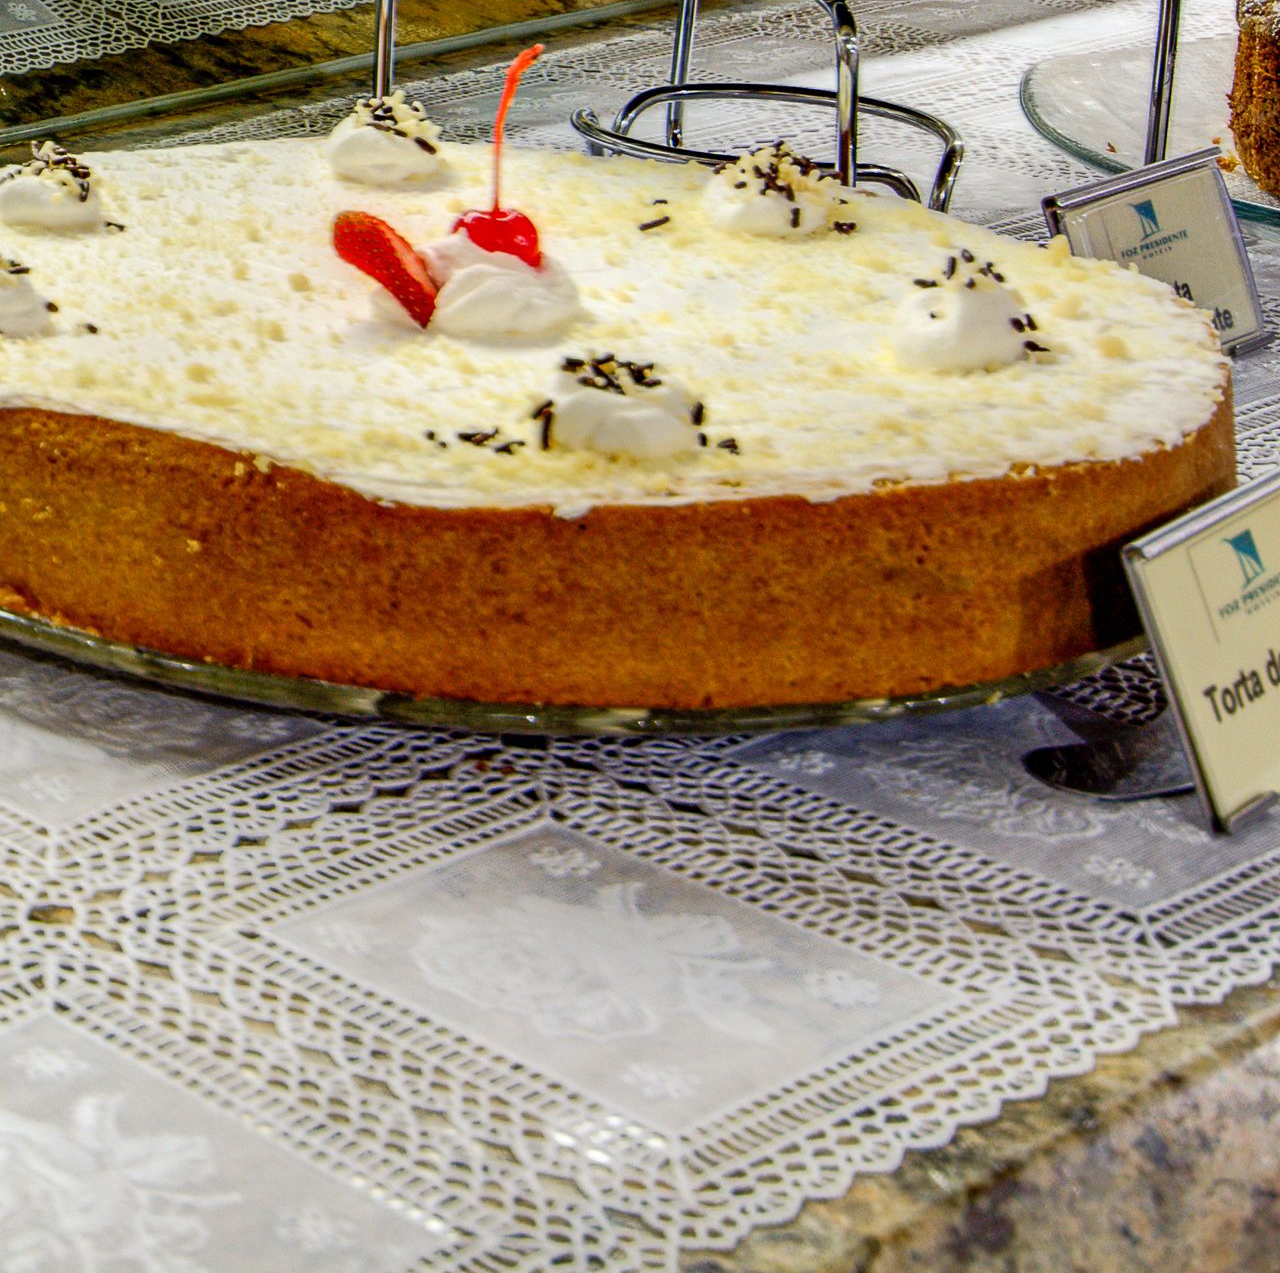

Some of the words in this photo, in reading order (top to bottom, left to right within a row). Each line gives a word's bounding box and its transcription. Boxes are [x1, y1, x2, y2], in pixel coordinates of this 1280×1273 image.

[1121, 246, 1139, 259] FOZ
[1140, 229, 1189, 252] PRESIDENTE
[1203, 669, 1265, 723] Torta
[1266, 648, 1280, 687] d
